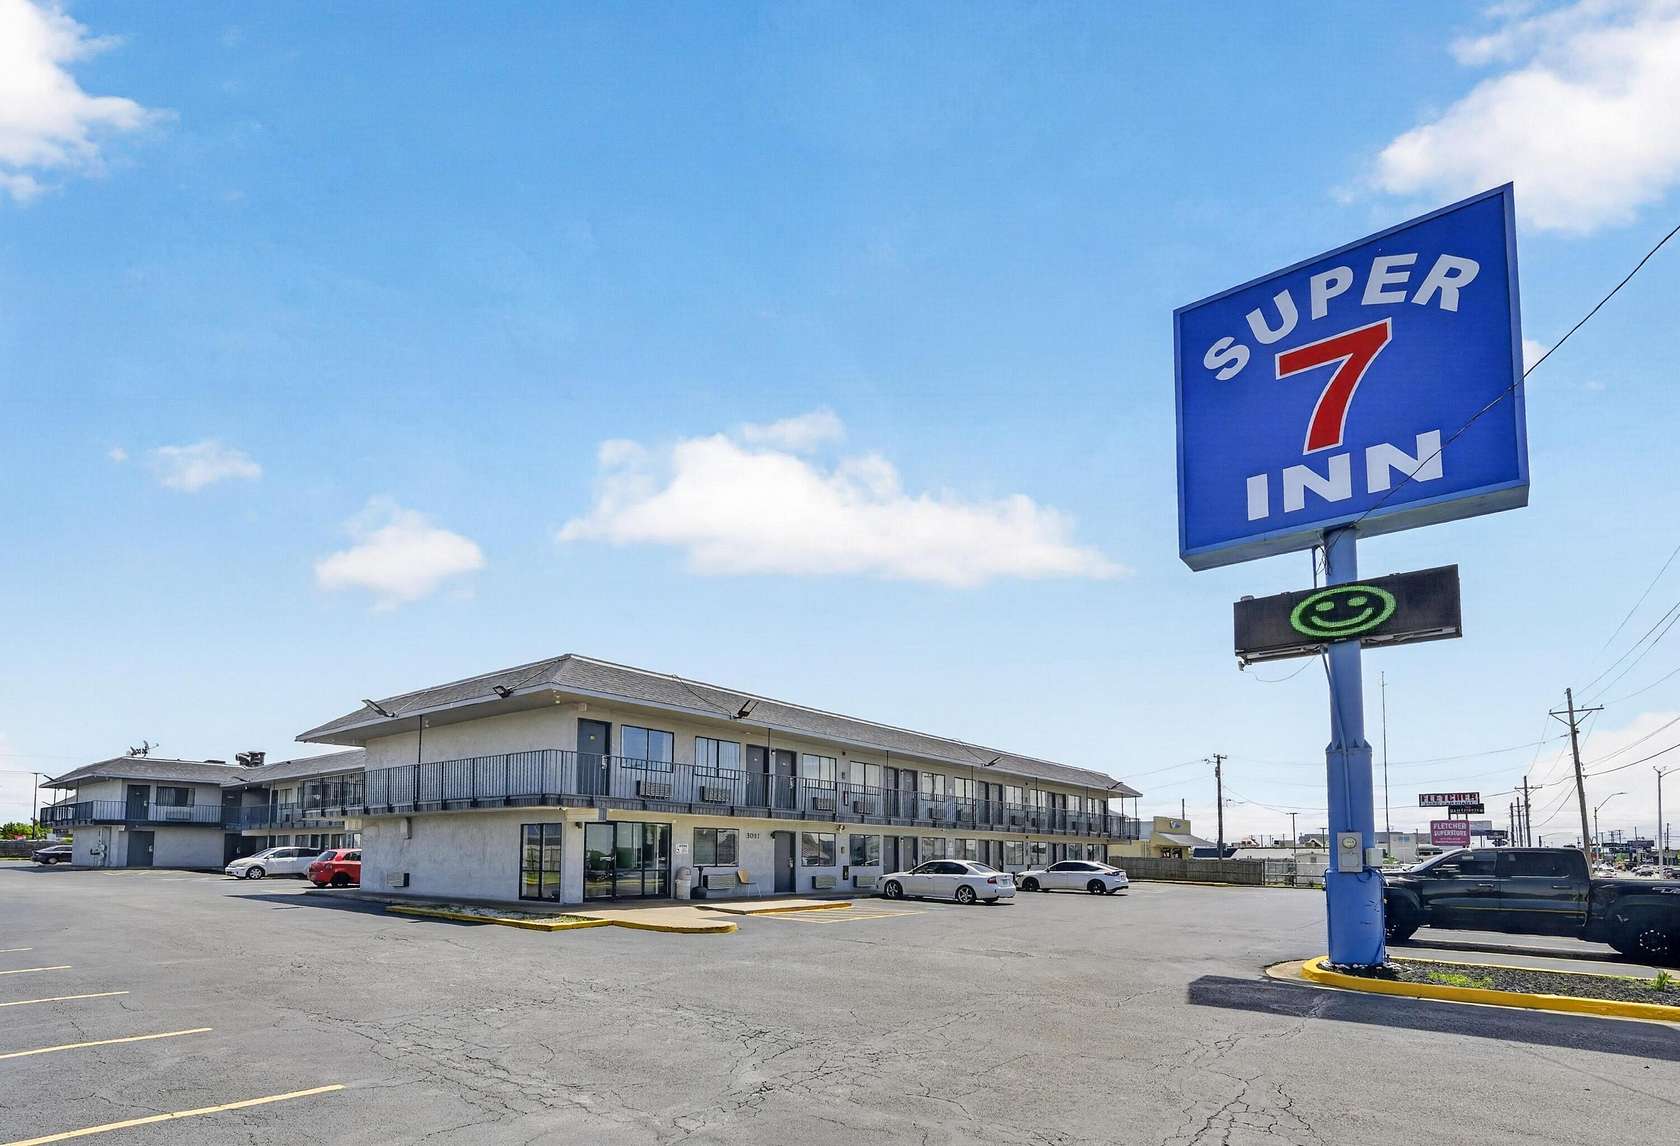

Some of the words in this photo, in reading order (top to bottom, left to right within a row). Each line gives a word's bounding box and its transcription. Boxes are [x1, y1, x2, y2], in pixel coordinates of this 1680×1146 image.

[1203, 252, 1480, 381] SUPER
[1275, 317, 1392, 455] 7
[1246, 429, 1443, 521] INN
